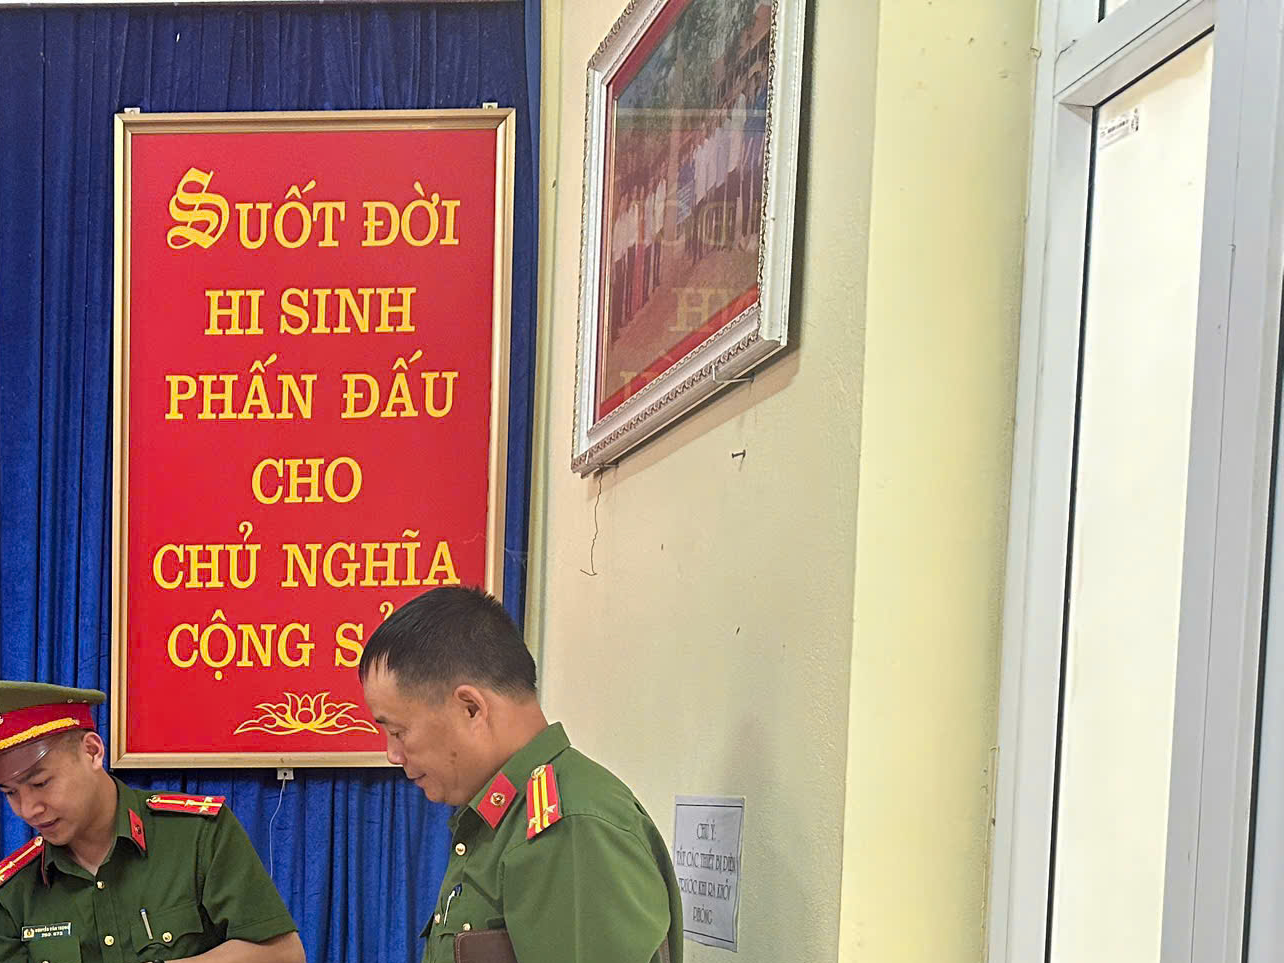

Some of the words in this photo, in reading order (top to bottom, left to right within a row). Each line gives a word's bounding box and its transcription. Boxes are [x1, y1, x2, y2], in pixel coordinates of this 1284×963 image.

[166, 167, 346, 251] SUỐT
[362, 181, 461, 248] ĐỜI
[204, 289, 264, 337] HI
[279, 286, 417, 336] SINH
[165, 353, 317, 421] PHẤN
[341, 350, 459, 419] ĐẤU
[251, 457, 363, 505] CHO
[152, 521, 262, 590] CHỦ
[281, 530, 461, 588] NGHĨA
[167, 608, 316, 681] CỘNG
